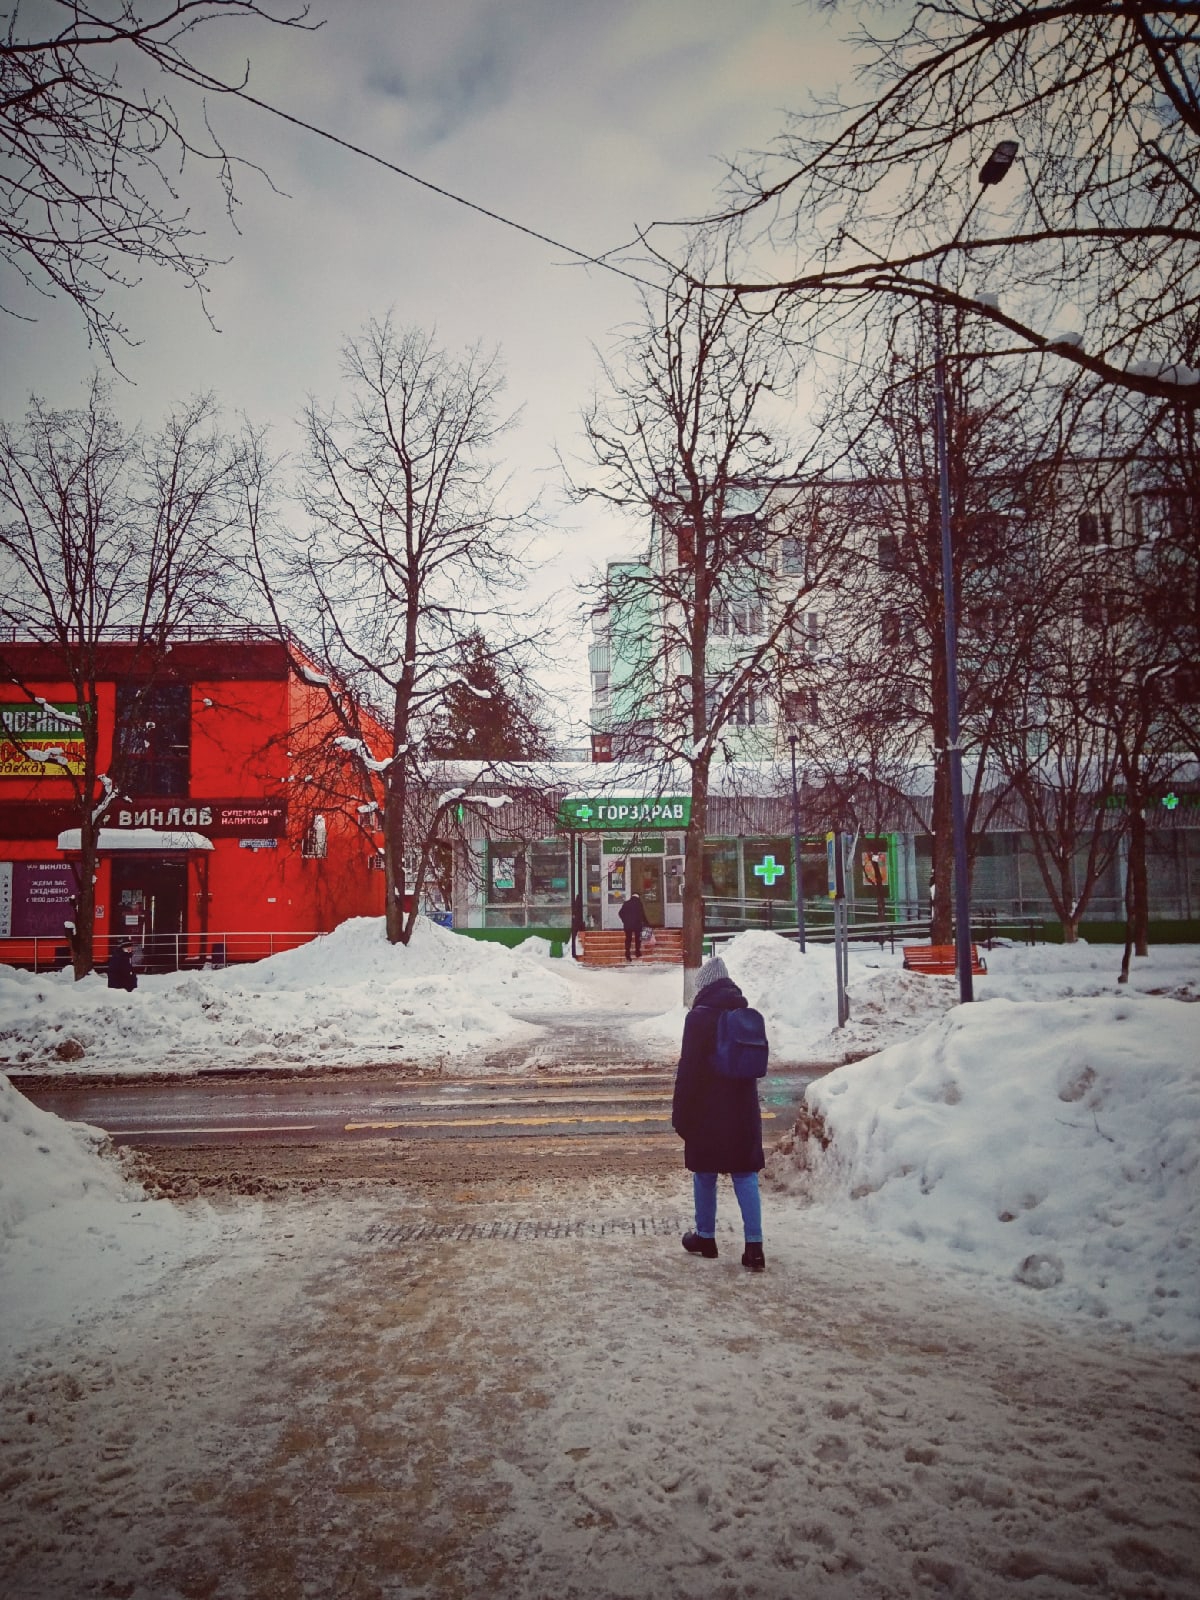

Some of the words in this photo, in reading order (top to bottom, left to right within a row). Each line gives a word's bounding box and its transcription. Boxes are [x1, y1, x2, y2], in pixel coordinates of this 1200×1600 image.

[221, 809, 282, 817] СУПЕРМАРКЕТ
[598, 804, 684, 822] ГОРЗДРАВ
[221, 817, 269, 825] НАПИТКОВ
[29, 887, 69, 895] ЕЖЕДНЕВНО
